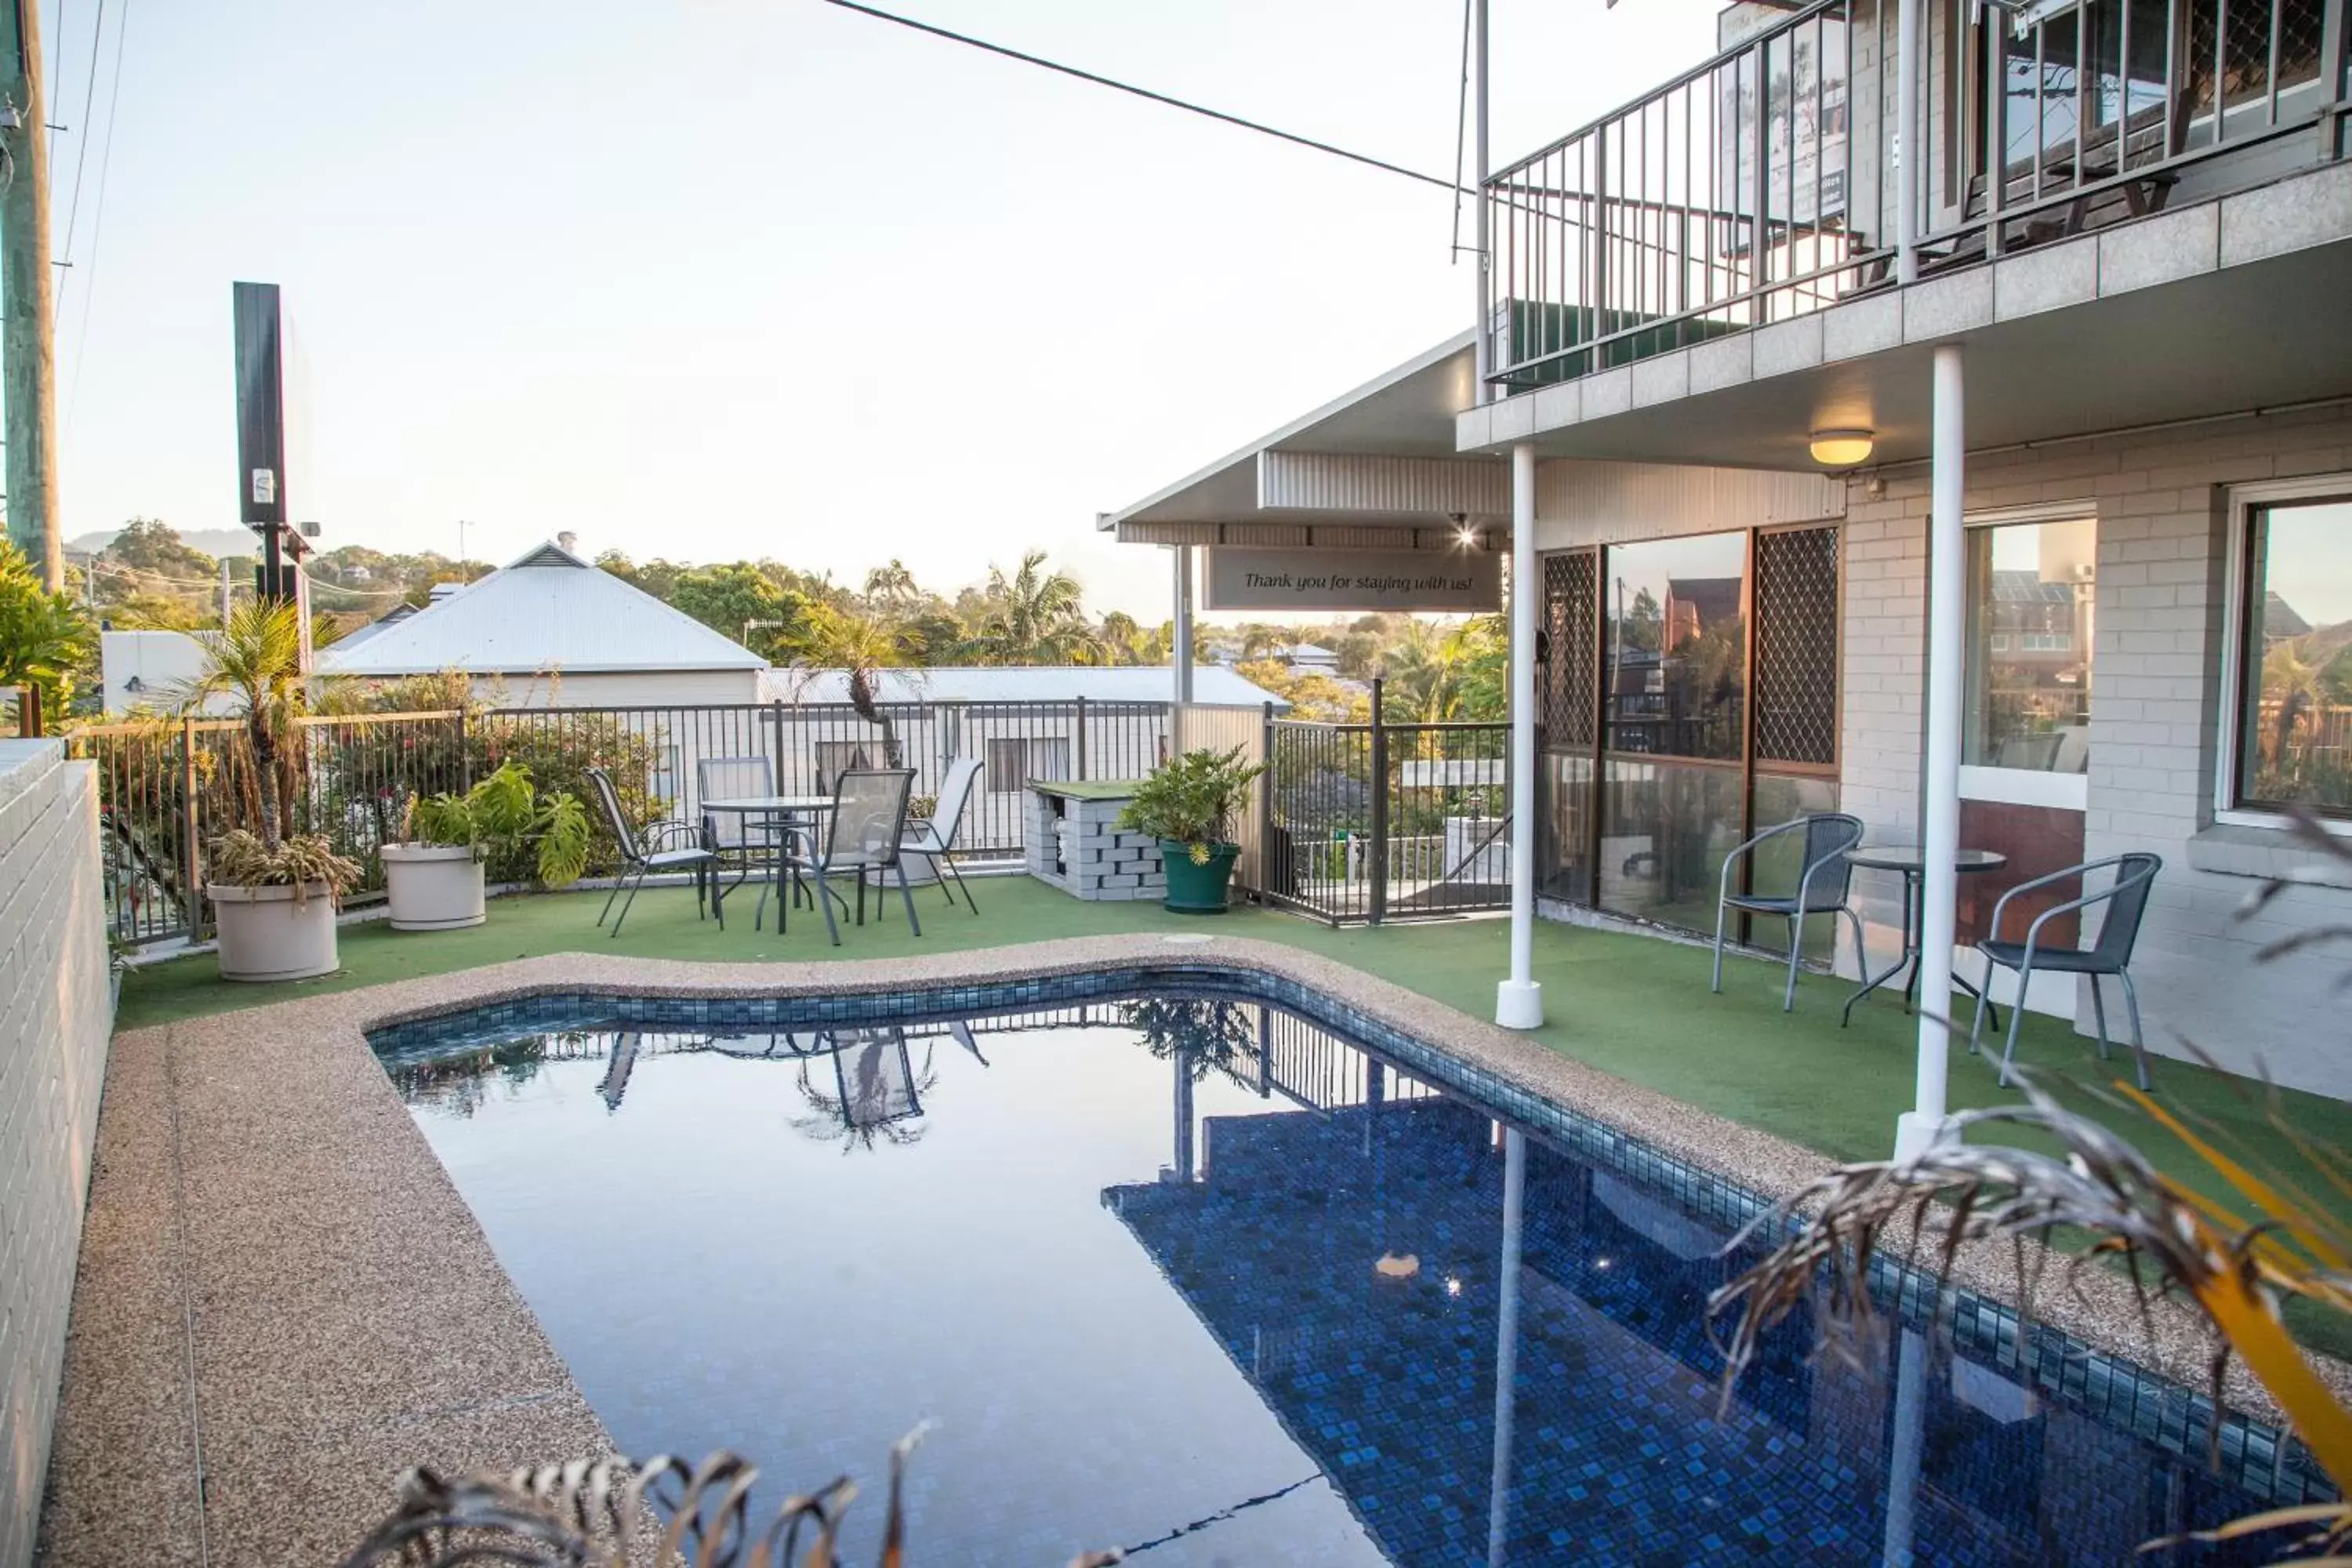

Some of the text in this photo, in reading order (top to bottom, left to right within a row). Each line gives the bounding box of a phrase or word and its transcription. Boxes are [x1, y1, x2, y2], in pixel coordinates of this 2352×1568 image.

[1245, 572, 1292, 587] Thank
[1296, 576, 1327, 592] you
[1330, 574, 1352, 590] for
[1356, 576, 1410, 593] staying
[1414, 576, 1446, 590] with
